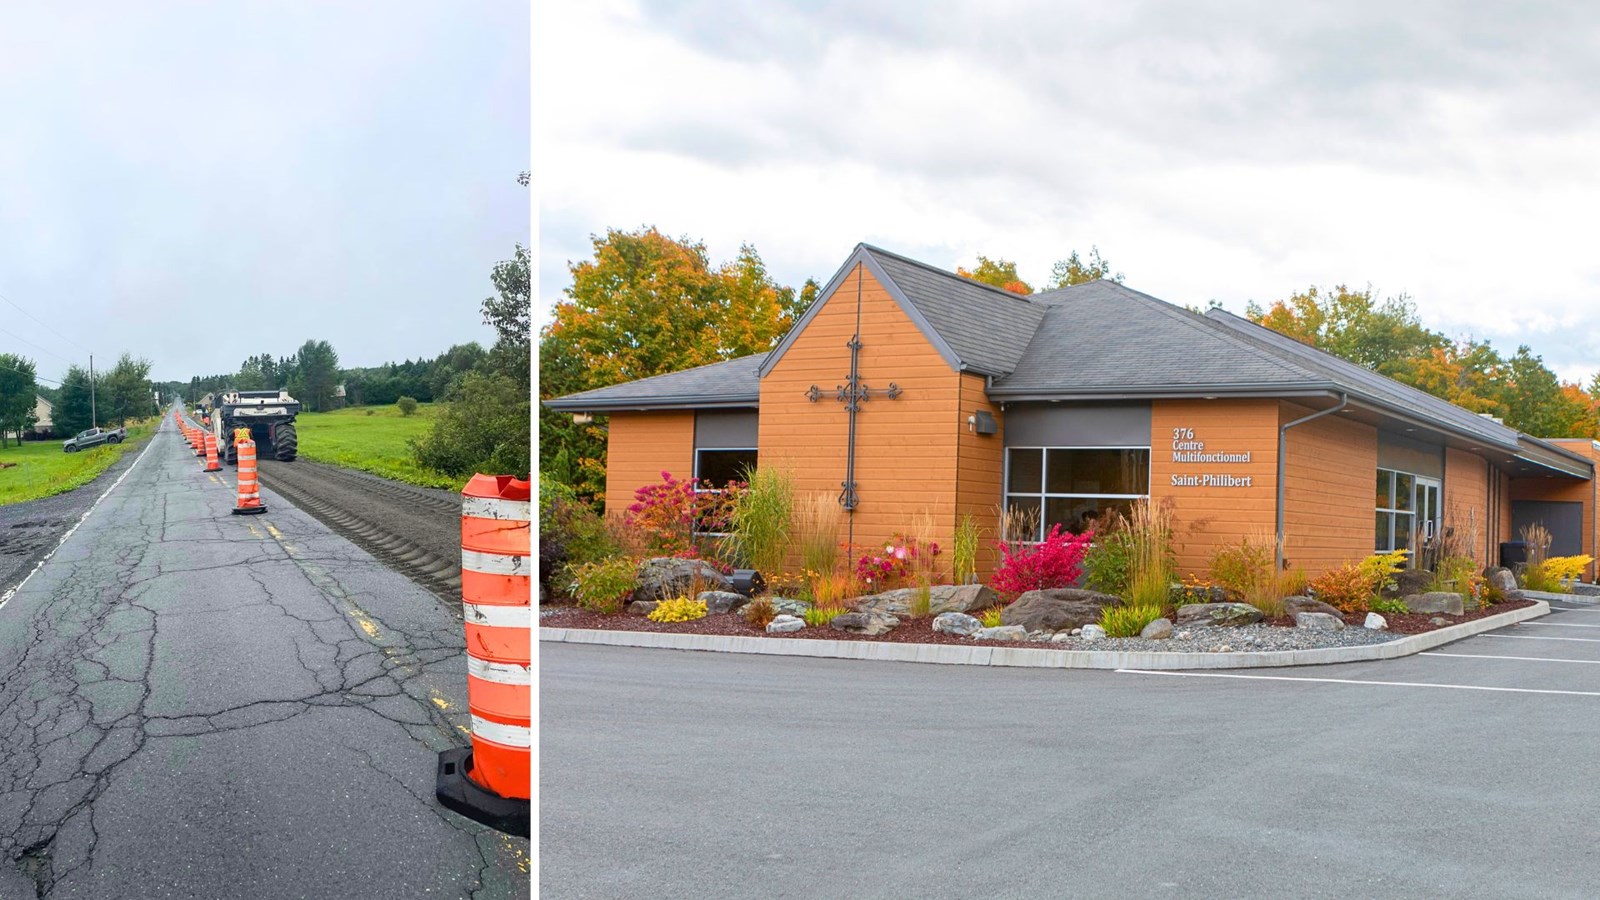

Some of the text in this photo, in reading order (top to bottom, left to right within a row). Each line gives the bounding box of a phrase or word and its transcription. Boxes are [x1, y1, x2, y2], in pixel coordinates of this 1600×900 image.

[1173, 428, 1194, 440] 376
[1172, 440, 1204, 450] Centre
[1172, 451, 1250, 462] Multifonctionnel
[1171, 474, 1252, 486] Saint-Philibert
